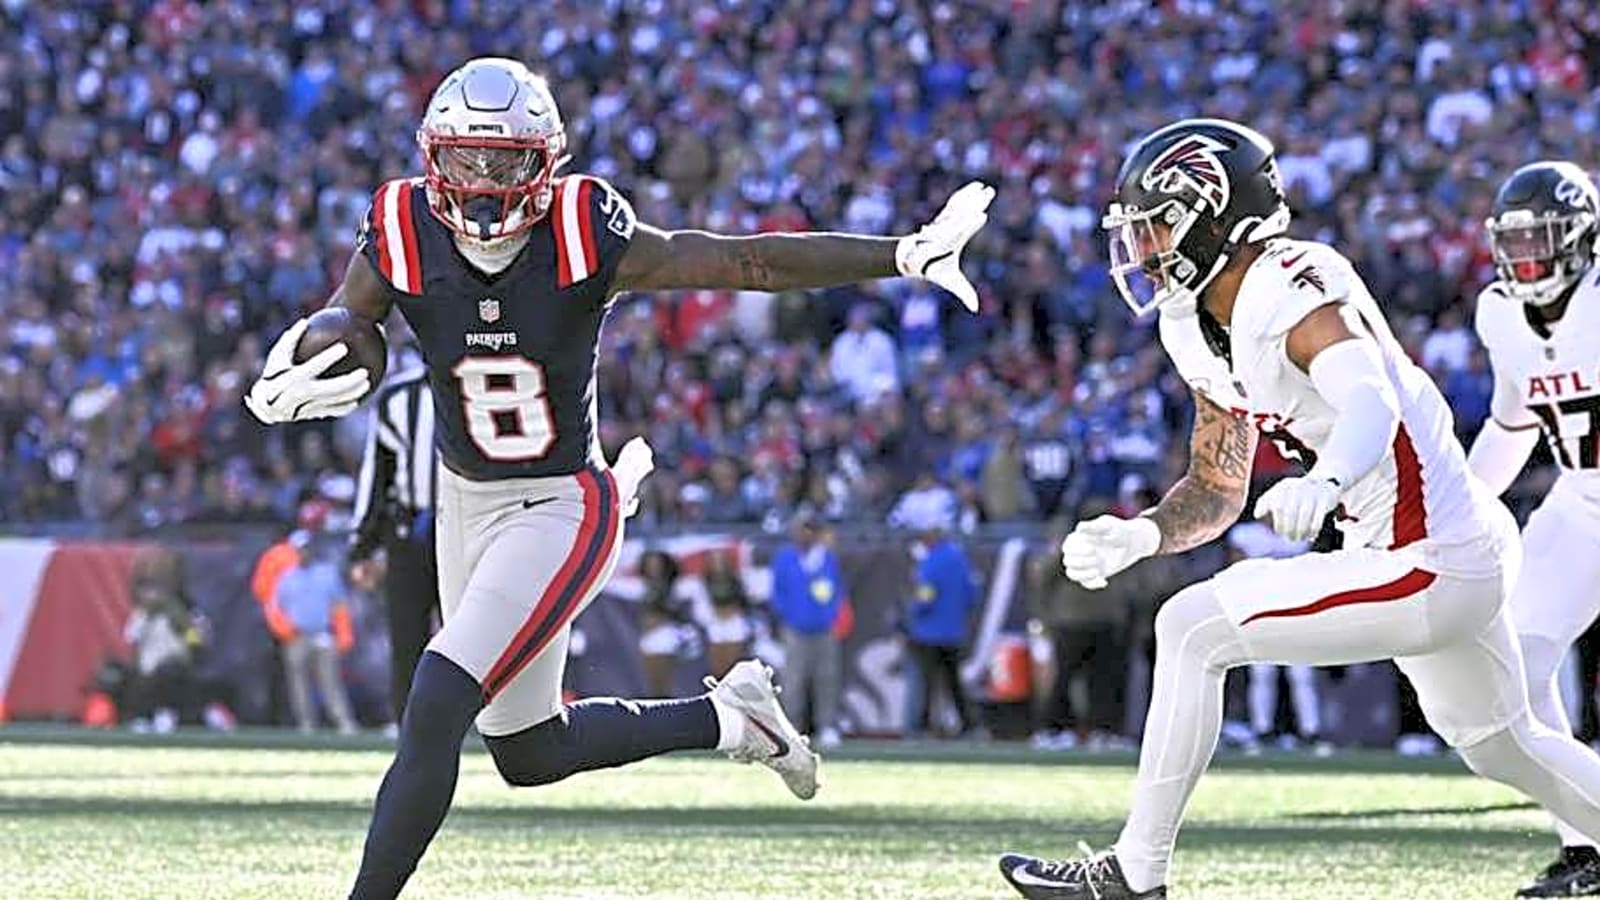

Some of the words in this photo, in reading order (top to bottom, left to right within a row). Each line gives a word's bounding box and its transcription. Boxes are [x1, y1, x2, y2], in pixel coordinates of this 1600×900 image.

[465, 332, 517, 350] PATRIOTS
[450, 355, 557, 460] 8
[1524, 394, 1600, 470] 17
